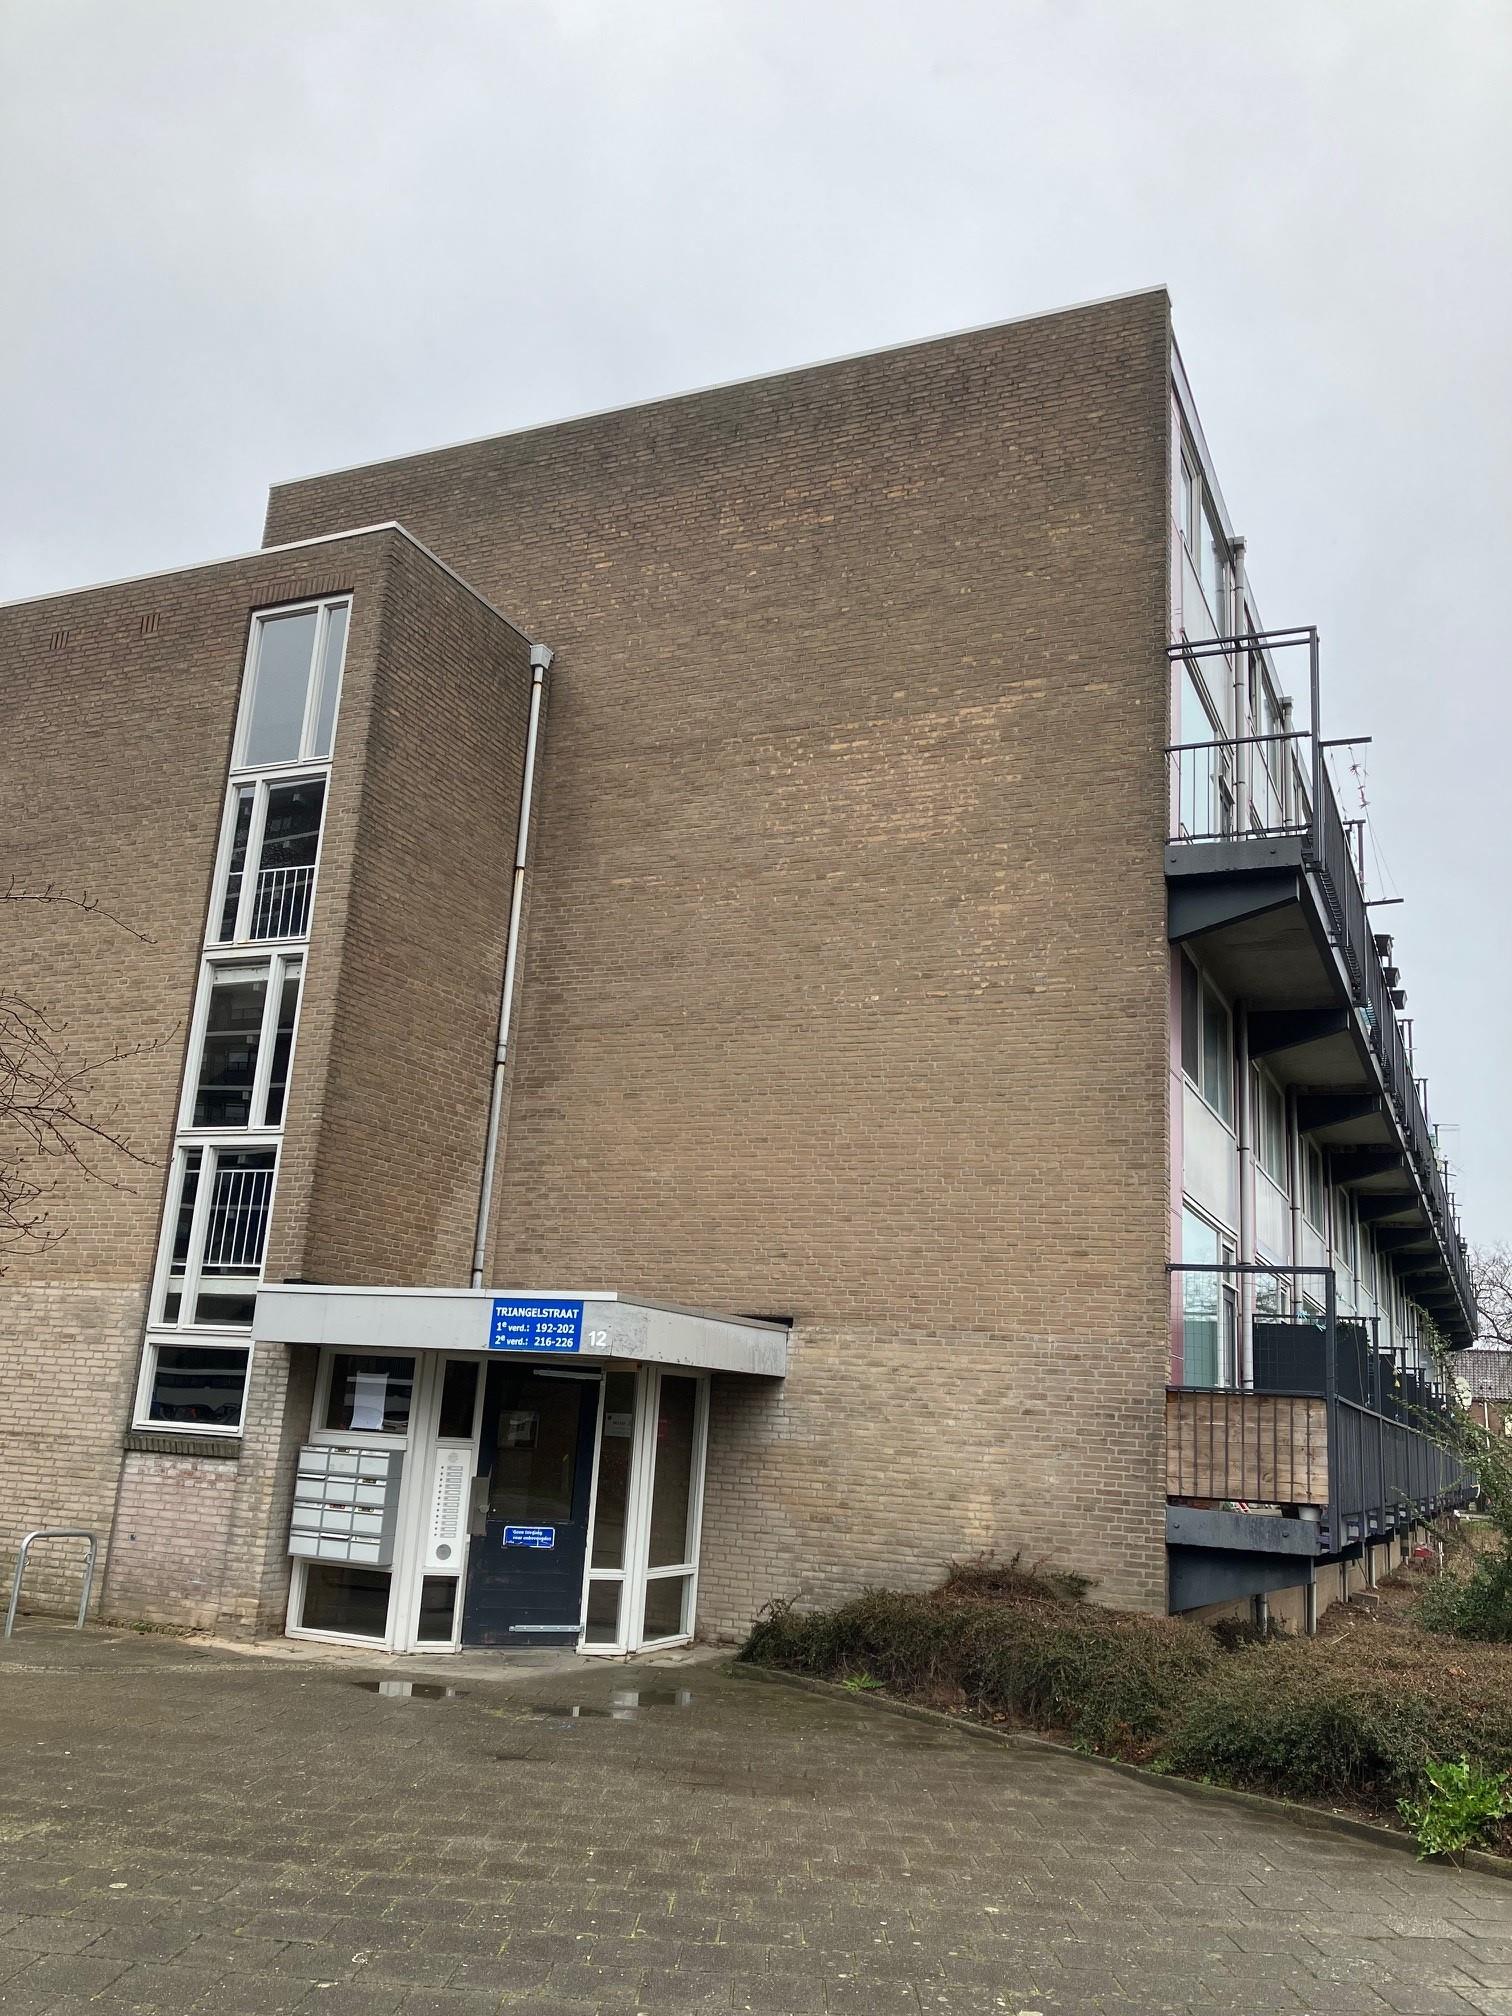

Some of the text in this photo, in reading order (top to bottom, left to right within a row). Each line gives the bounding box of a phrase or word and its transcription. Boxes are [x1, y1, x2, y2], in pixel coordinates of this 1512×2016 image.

[496, 1307, 579, 1319] TRIANGELSTRAAT
[508, 1324, 530, 1332] verd.:
[535, 1323, 575, 1333] 192-202
[506, 1337, 529, 1346] verd.:
[534, 1337, 574, 1347] 216-226
[588, 1330, 608, 1347] 12
